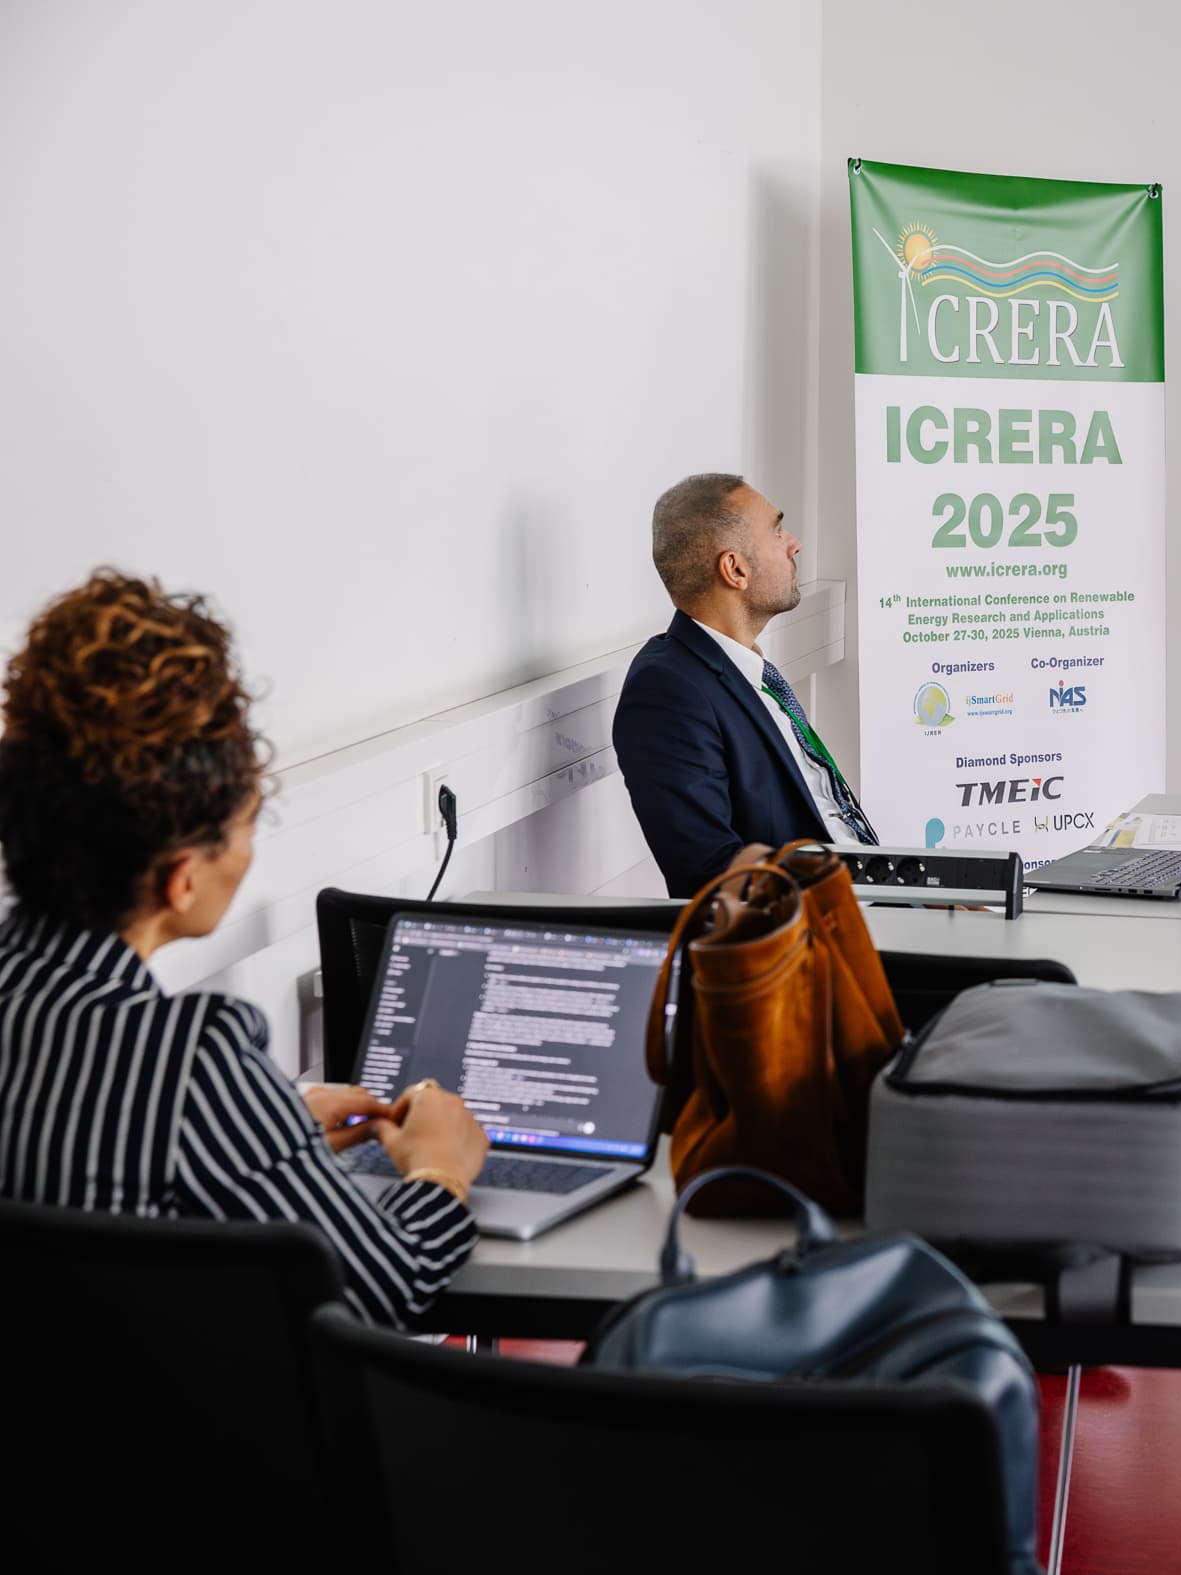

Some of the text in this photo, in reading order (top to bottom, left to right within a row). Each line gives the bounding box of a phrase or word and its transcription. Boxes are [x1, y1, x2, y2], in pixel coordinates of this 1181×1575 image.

[886, 405, 1123, 465] ICRERA
[931, 493, 1078, 548] 2025
[946, 562, 1067, 579] www.icrera.org
[906, 595, 981, 607] International
[985, 593, 1049, 606] Conference
[1053, 594, 1067, 604] on
[1070, 591, 1135, 603] Renewable
[908, 609, 1105, 626] Energy Research and Applications
[903, 625, 1110, 643] October 27-30, 2025 Vienna, Austria
[931, 661, 995, 675] Organizers
[1030, 656, 1105, 671] Co-Organizer
[956, 752, 1063, 768] Diamond Sponsors
[955, 776, 1064, 807] TMEIC
[953, 820, 1021, 839] PAYCLE
[1053, 811, 1095, 831] UPCX
